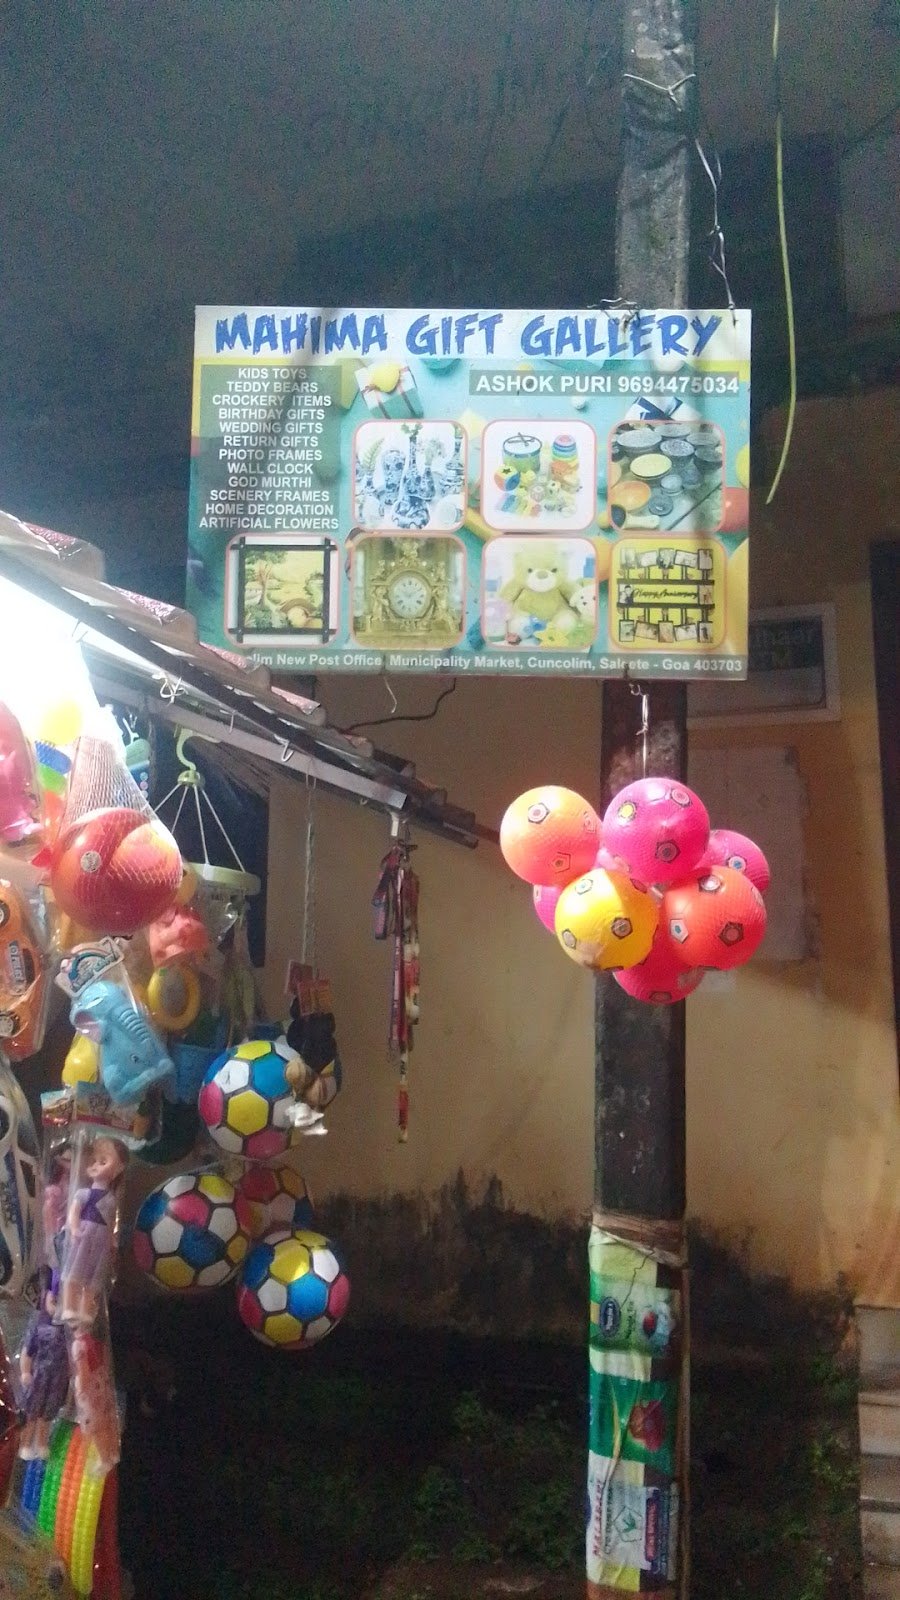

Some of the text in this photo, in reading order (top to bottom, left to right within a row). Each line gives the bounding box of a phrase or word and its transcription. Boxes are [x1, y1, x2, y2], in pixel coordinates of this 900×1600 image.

[215, 312, 722, 358] MAHIMA GIFT GALLERY
[238, 368, 307, 379] KIDS TOYS
[227, 381, 318, 392] TEDDY BEARS
[476, 376, 739, 394] ASHOK PURI 9694475034
[212, 395, 331, 406] CROCKERY ITEMS
[219, 409, 325, 420] BIRTHDAY GIFTS
[219, 422, 323, 433] WEDDING GIFTS
[224, 436, 318, 447] RETURN GIFTS
[219, 450, 322, 461] PHOTO FRAMES
[227, 463, 314, 474] WALL CLOCK
[228, 477, 311, 487] GOD MURTHI
[210, 490, 329, 501] SCENERY FRAMES
[205, 504, 334, 515] HOME DECORATION
[199, 518, 339, 529] ARTIFICIAL FLOWERS
[277, 654, 306, 665] New
[309, 654, 339, 665] Post
[343, 654, 382, 666] Office
[389, 655, 470, 669] Municipality
[475, 658, 523, 670] Market,
[528, 658, 596, 671] Cuncolim,
[662, 659, 690, 671] Goa
[693, 659, 742, 672] 403703
